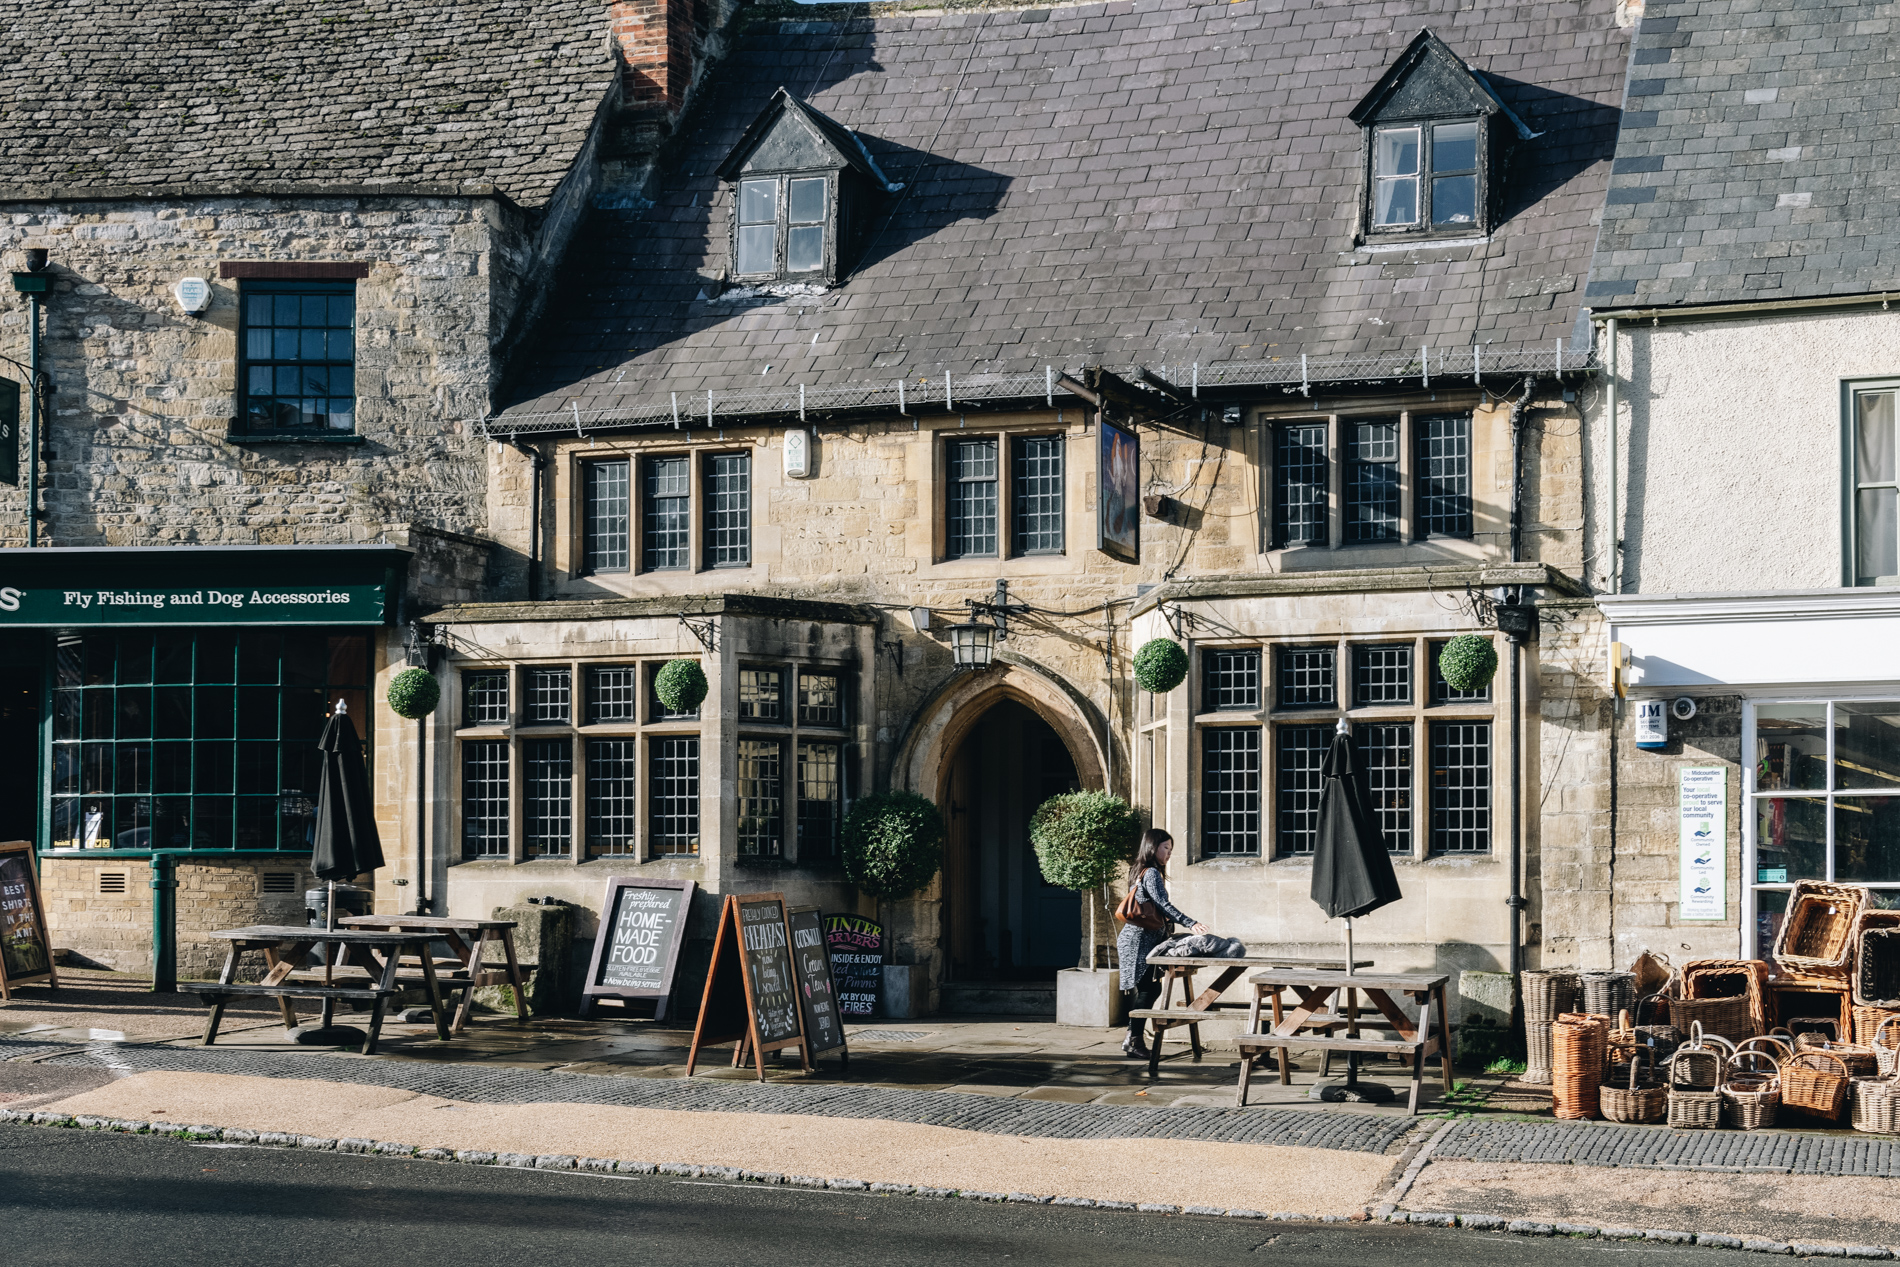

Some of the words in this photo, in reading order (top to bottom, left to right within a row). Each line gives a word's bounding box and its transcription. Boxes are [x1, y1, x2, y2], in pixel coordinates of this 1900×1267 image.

[63, 591, 93, 609] Fly
[97, 591, 166, 609] Fishing
[170, 591, 204, 605] and
[207, 591, 244, 608] Dog
[249, 590, 350, 604] Accessories
[1639, 704, 1661, 718] JM
[3, 884, 26, 896] BEST
[622, 891, 660, 901] Freshly-
[628, 898, 672, 910] prepared
[7, 915, 15, 925] IN
[620, 910, 672, 929] HOME-
[615, 928, 662, 946] MADE
[743, 922, 786, 951] BREAKFAST
[795, 927, 821, 949] COTSWOLD
[828, 932, 880, 949] ARMERS
[611, 945, 657, 964] FOOD
[803, 953, 825, 974] Cream
[618, 971, 648, 979] AVAILABLE
[622, 978, 641, 989] being
[641, 981, 661, 989] served
[850, 993, 860, 1001] BY
[860, 993, 876, 1002] OUR
[813, 1004, 821, 1014] NOW
[844, 1001, 873, 1013] FIRES
